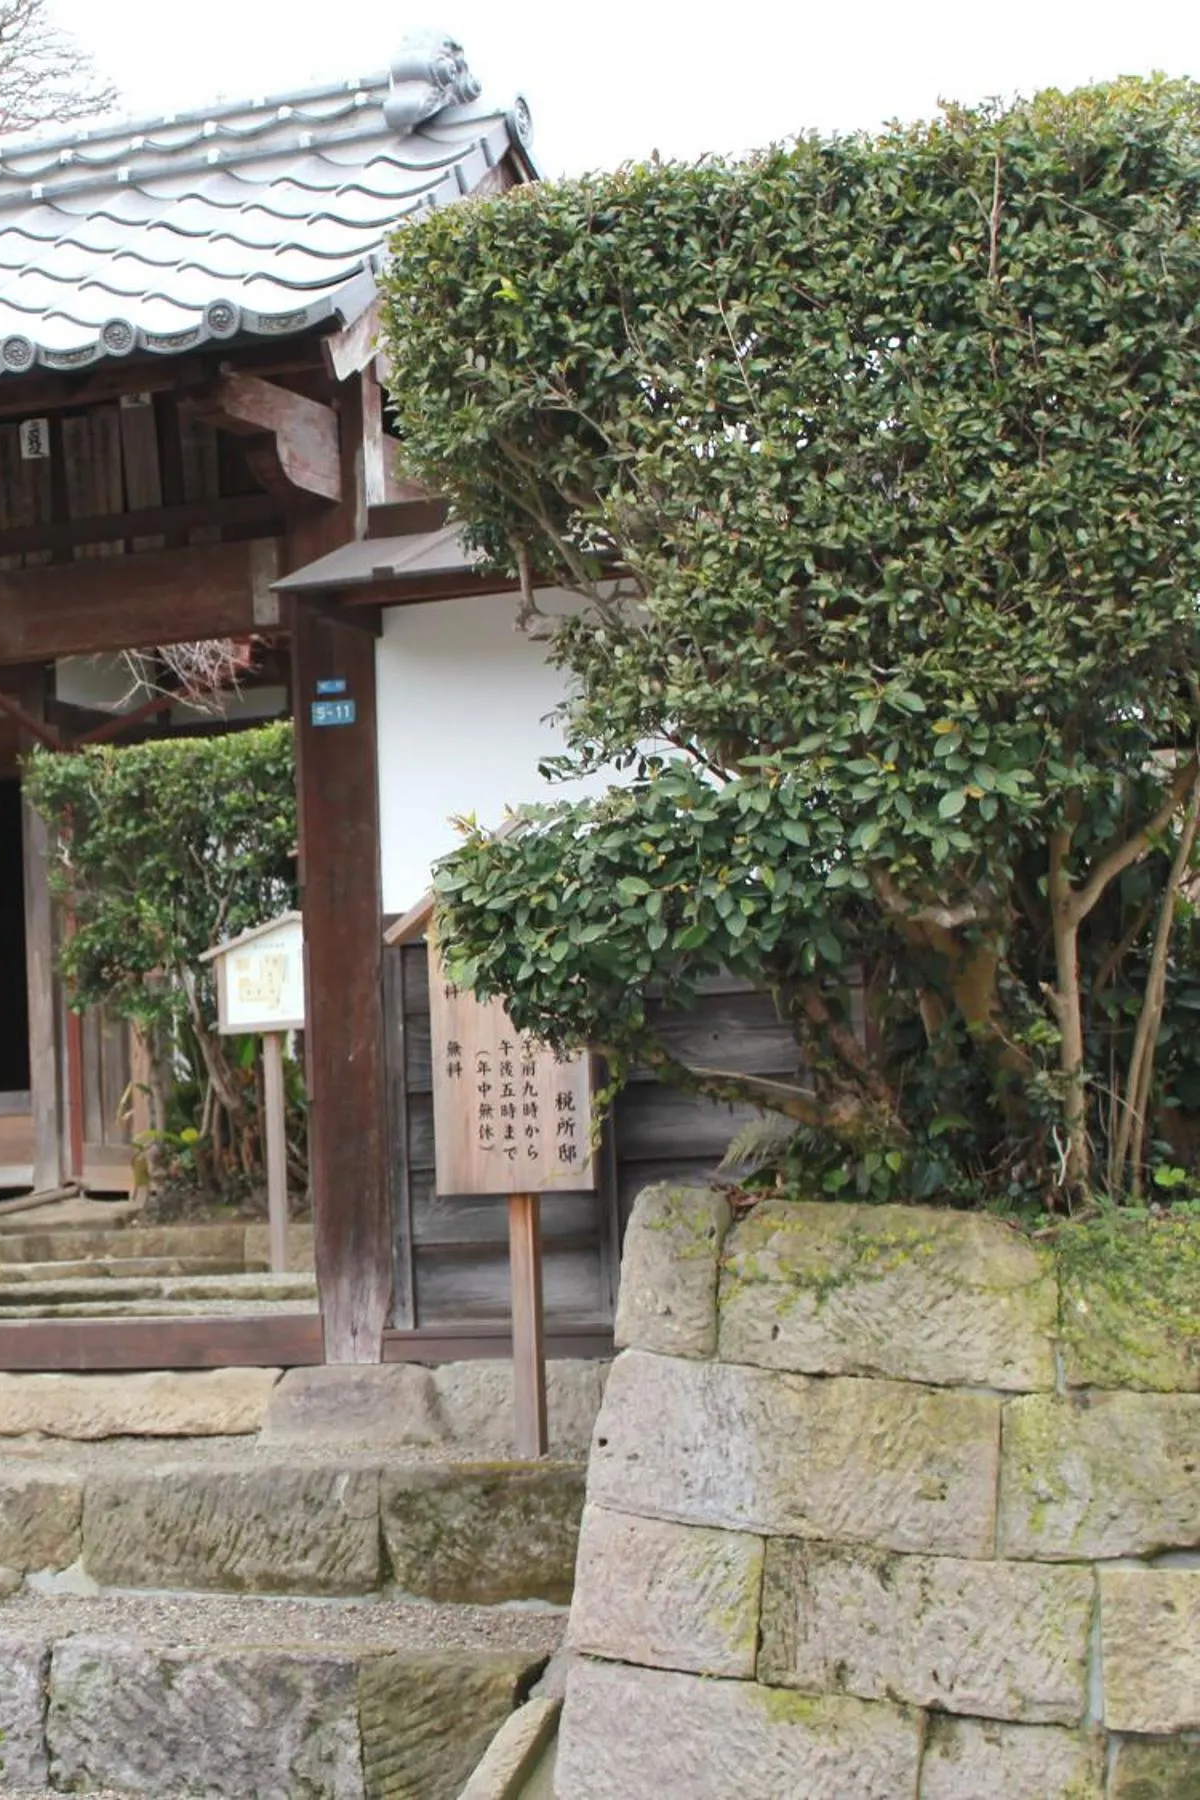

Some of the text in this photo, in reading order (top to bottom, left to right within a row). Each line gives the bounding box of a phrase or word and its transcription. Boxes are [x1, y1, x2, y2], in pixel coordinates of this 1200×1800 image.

[315, 704, 350, 720] 5-11
[446, 1040, 463, 1080] 無料
[498, 1039, 517, 1161] 午後五時まで
[555, 1089, 577, 1164] 税所邸
